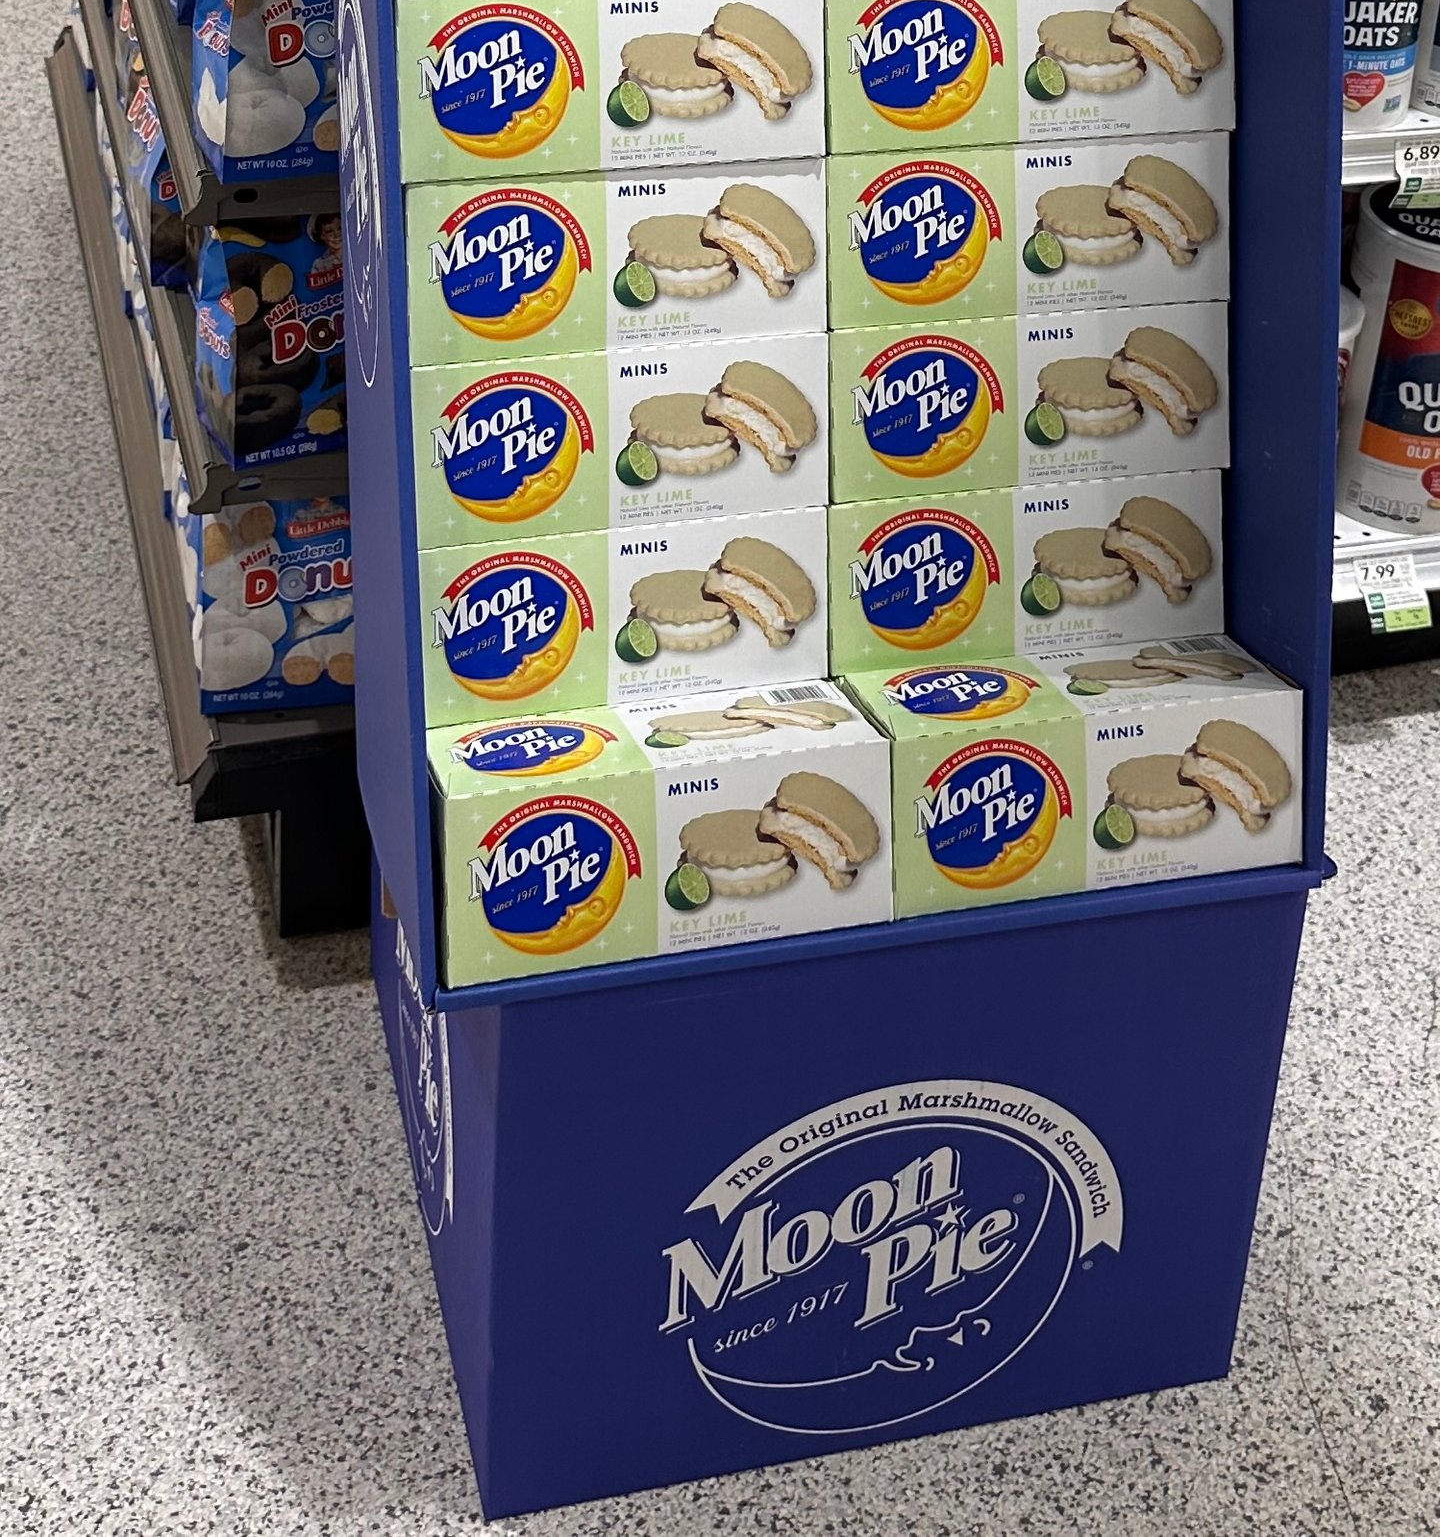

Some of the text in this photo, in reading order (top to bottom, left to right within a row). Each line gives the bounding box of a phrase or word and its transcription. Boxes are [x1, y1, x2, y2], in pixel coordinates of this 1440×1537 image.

[292, 0, 335, 21] Powd
[610, 0, 658, 13] MINIS
[848, 8, 945, 73] Moon
[914, 33, 966, 83] Pie
[1343, 25, 1400, 47] OATS
[418, 30, 522, 98] Moon
[490, 56, 545, 109] Pie
[236, 161, 251, 171] NET
[252, 160, 265, 170] WT
[1026, 155, 1072, 168] MINIS
[1404, 145, 1440, 161] 6.89
[618, 183, 666, 196] MINIS
[848, 184, 944, 250] Moon
[914, 209, 965, 259] Pie
[429, 214, 531, 282] Moon
[499, 240, 553, 292] Pie
[309, 275, 337, 288] Little
[264, 294, 298, 329] Mini
[1028, 327, 1073, 341] MINIS
[620, 362, 667, 377] MINIS
[852, 359, 947, 424] Moon
[917, 383, 967, 432] Pie
[430, 396, 533, 467] Moon
[501, 422, 555, 475] Pie
[1406, 444, 1430, 459] OLD
[246, 454, 259, 464] NET
[260, 449, 271, 461] WT
[1024, 499, 1069, 513] MINIS
[240, 539, 344, 571] Mini Powdered
[620, 540, 667, 555] MINIS
[849, 532, 943, 598] Moon
[243, 556, 353, 607] Donu
[914, 556, 964, 605] Pie
[1360, 563, 1395, 581] 7.99
[432, 576, 534, 647] Moon
[502, 602, 555, 654] Pie
[1038, 650, 1085, 662] MINIS
[884, 670, 970, 706] Moon
[957, 676, 1001, 703] Pie
[450, 725, 549, 765] Moon
[522, 729, 577, 753] Pie
[1097, 724, 1144, 741] MINIS
[668, 778, 719, 796] MINIS
[938, 743, 1068, 806] THE ORIGINAL MARSHMALLOW SANDWICH
[915, 764, 1013, 837] Moon
[982, 789, 1034, 842] Pie
[494, 799, 636, 865] THE ORIGINAL MARSHMALLOW SANDWICH
[468, 821, 576, 900] Moon
[543, 849, 600, 905] Pie
[1098, 851, 1169, 869] KEY LIME
[492, 885, 539, 914] since 1917
[670, 911, 748, 932] KEY LIME
[725, 1090, 1112, 1221] The Original Marshmallow Sandwich
[657, 1145, 962, 1335] Moon
[854, 1203, 1018, 1329] Pie
[711, 1280, 850, 1354] since 1917
